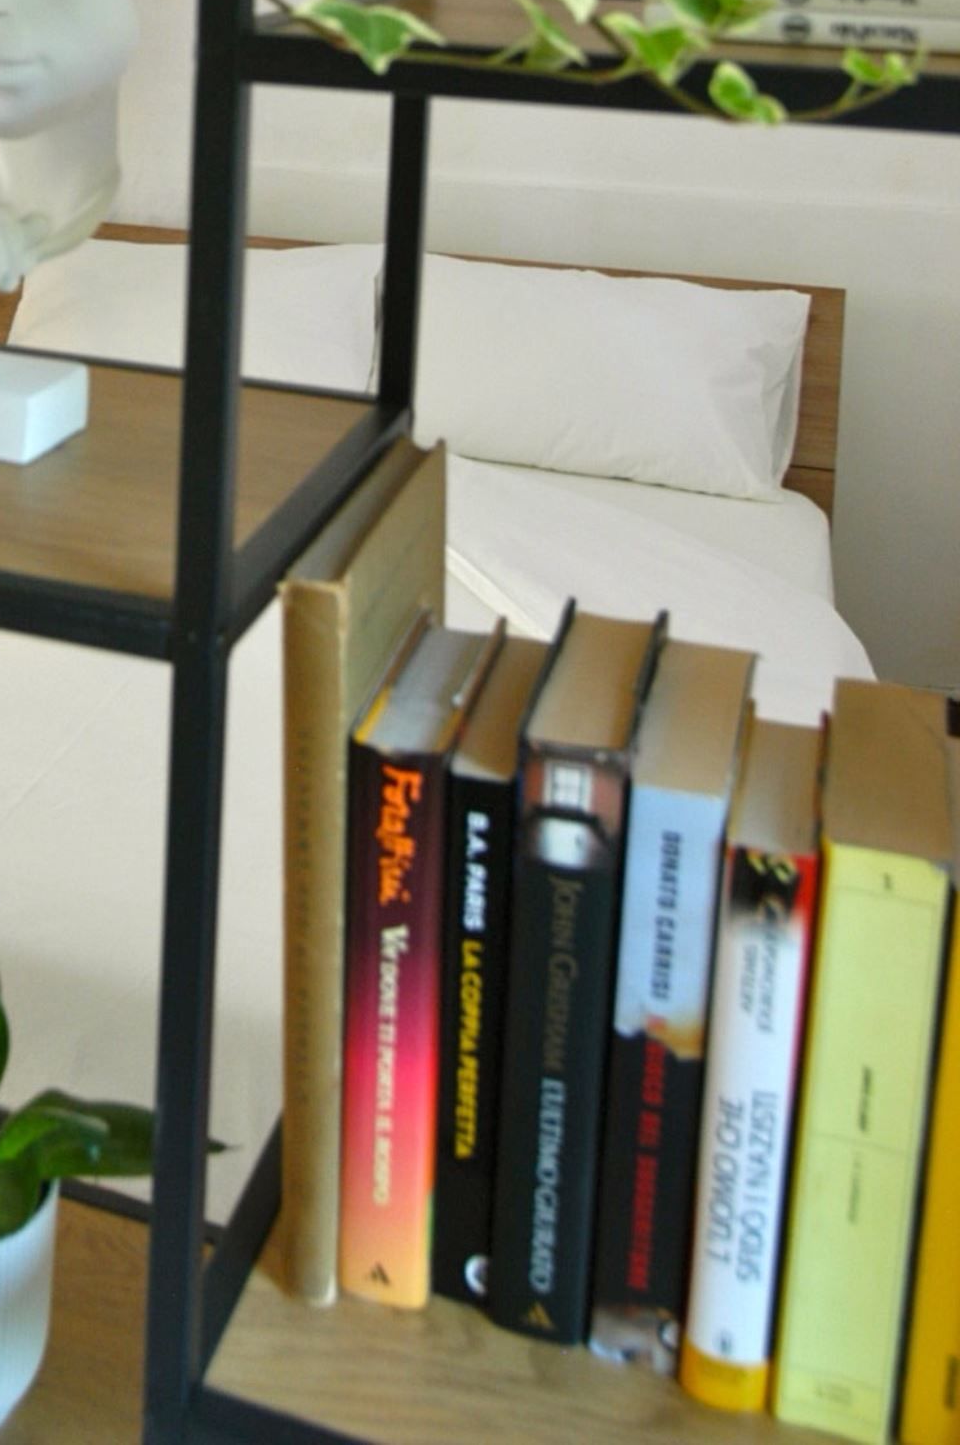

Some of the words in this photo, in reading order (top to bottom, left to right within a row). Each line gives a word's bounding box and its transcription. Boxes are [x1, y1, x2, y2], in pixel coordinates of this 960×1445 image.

[464, 810, 490, 858] B.A.
[655, 830, 682, 911] DONATO
[462, 862, 485, 932] PARIS
[460, 939, 483, 969] LA
[651, 916, 675, 1003] CARRISI
[456, 971, 482, 1053] COPPIA
[453, 1054, 479, 1161] PERFETTA
[715, 1095, 745, 1150] CHE
[745, 1090, 779, 1189] NAZISTI
